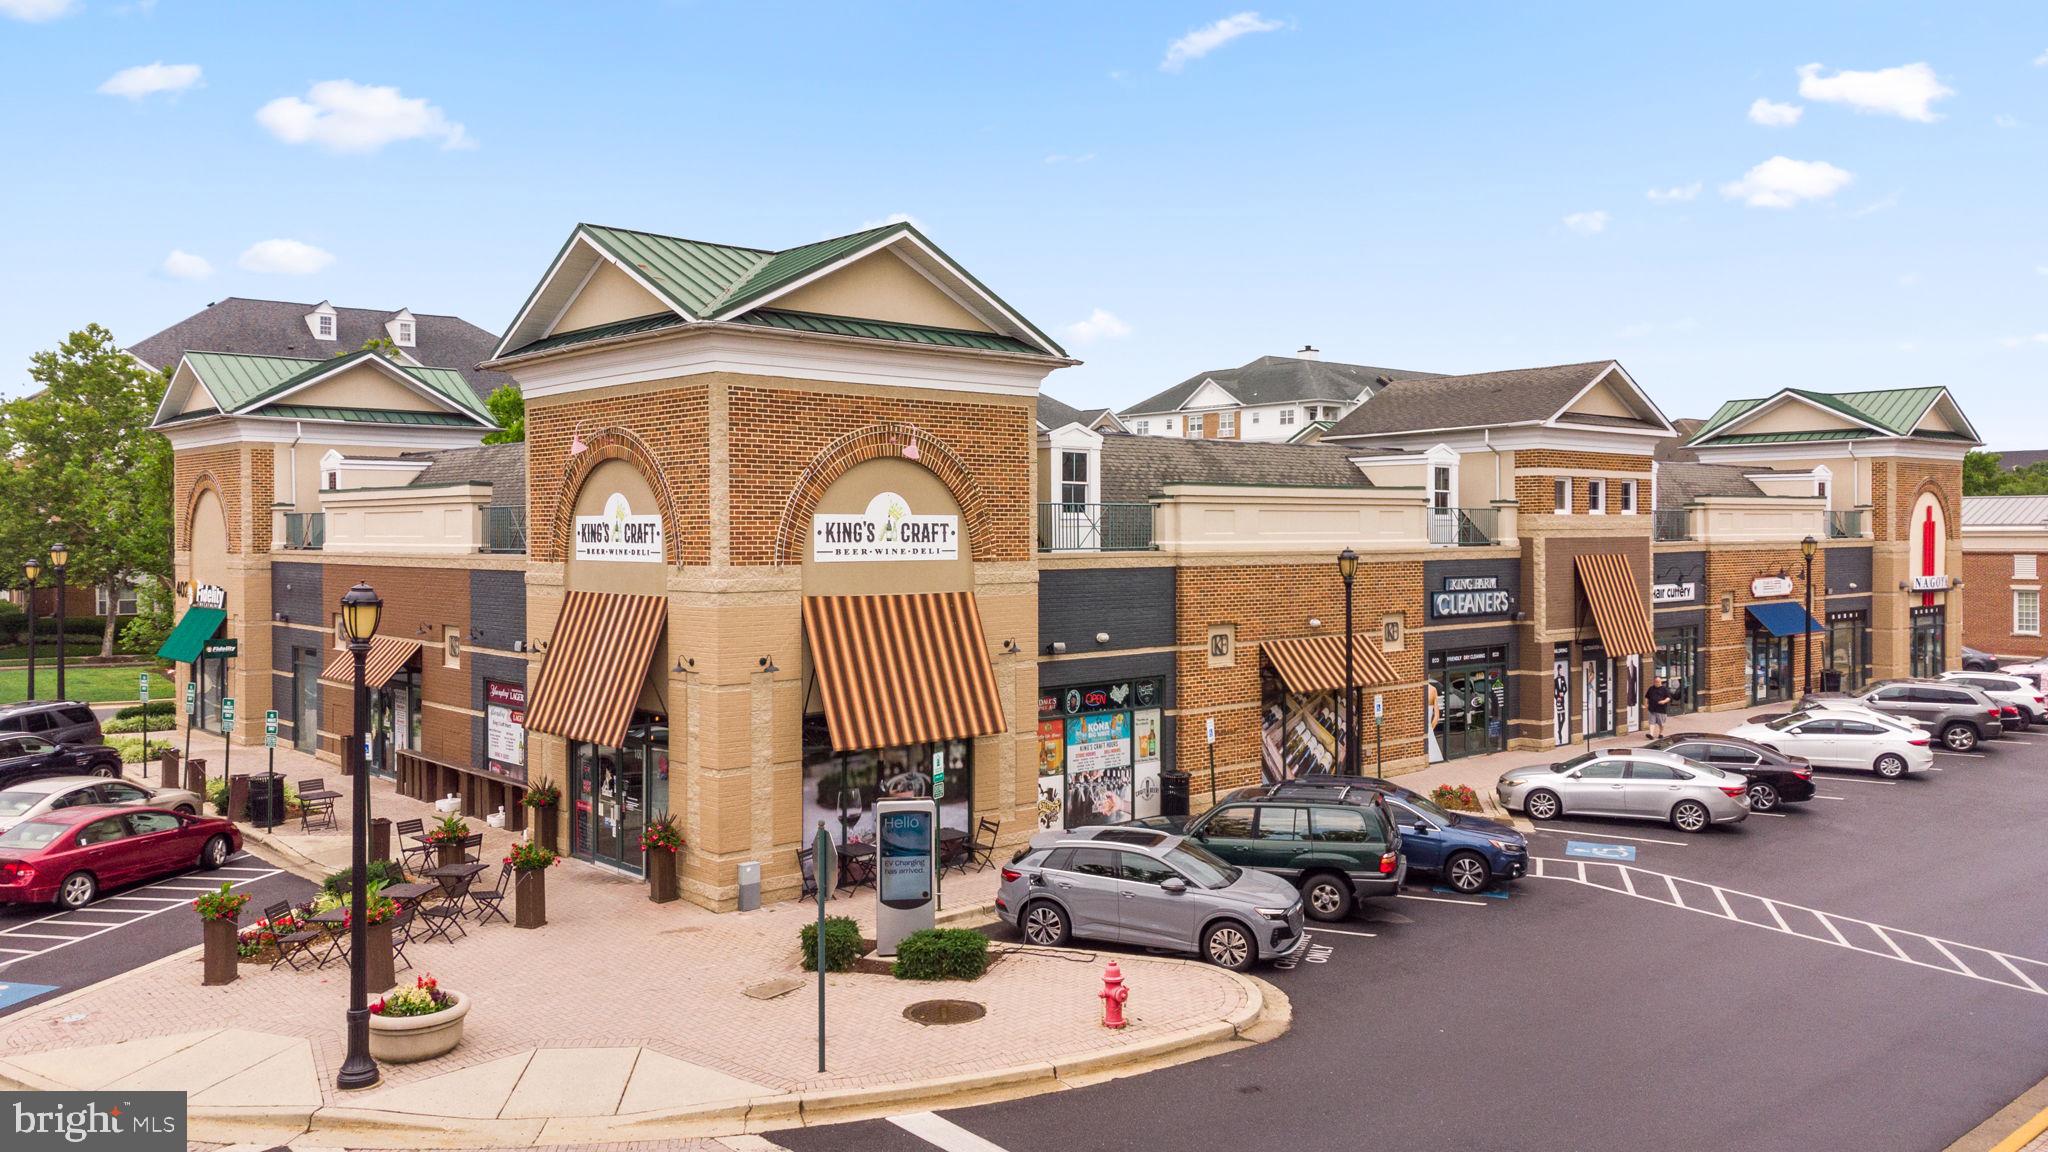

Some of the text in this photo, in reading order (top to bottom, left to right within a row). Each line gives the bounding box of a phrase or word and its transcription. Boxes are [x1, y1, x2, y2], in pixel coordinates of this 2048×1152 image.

[581, 522, 656, 544] KING'S CRAFT
[825, 520, 949, 543] KING'S CRAFT
[1449, 577, 1498, 590] KING FARM
[196, 583, 224, 609] Fidelity
[1667, 585, 1690, 598] cuttery
[1437, 591, 1509, 616] CLEANERS
[212, 645, 236, 653] Fidelity
[1085, 692, 1106, 705] OPEN
[1087, 722, 1110, 733] KONA
[884, 815, 920, 829] Hello
[895, 859, 925, 868] Charging
[884, 867, 898, 875] has
[1305, 943, 1334, 964] ONLY
